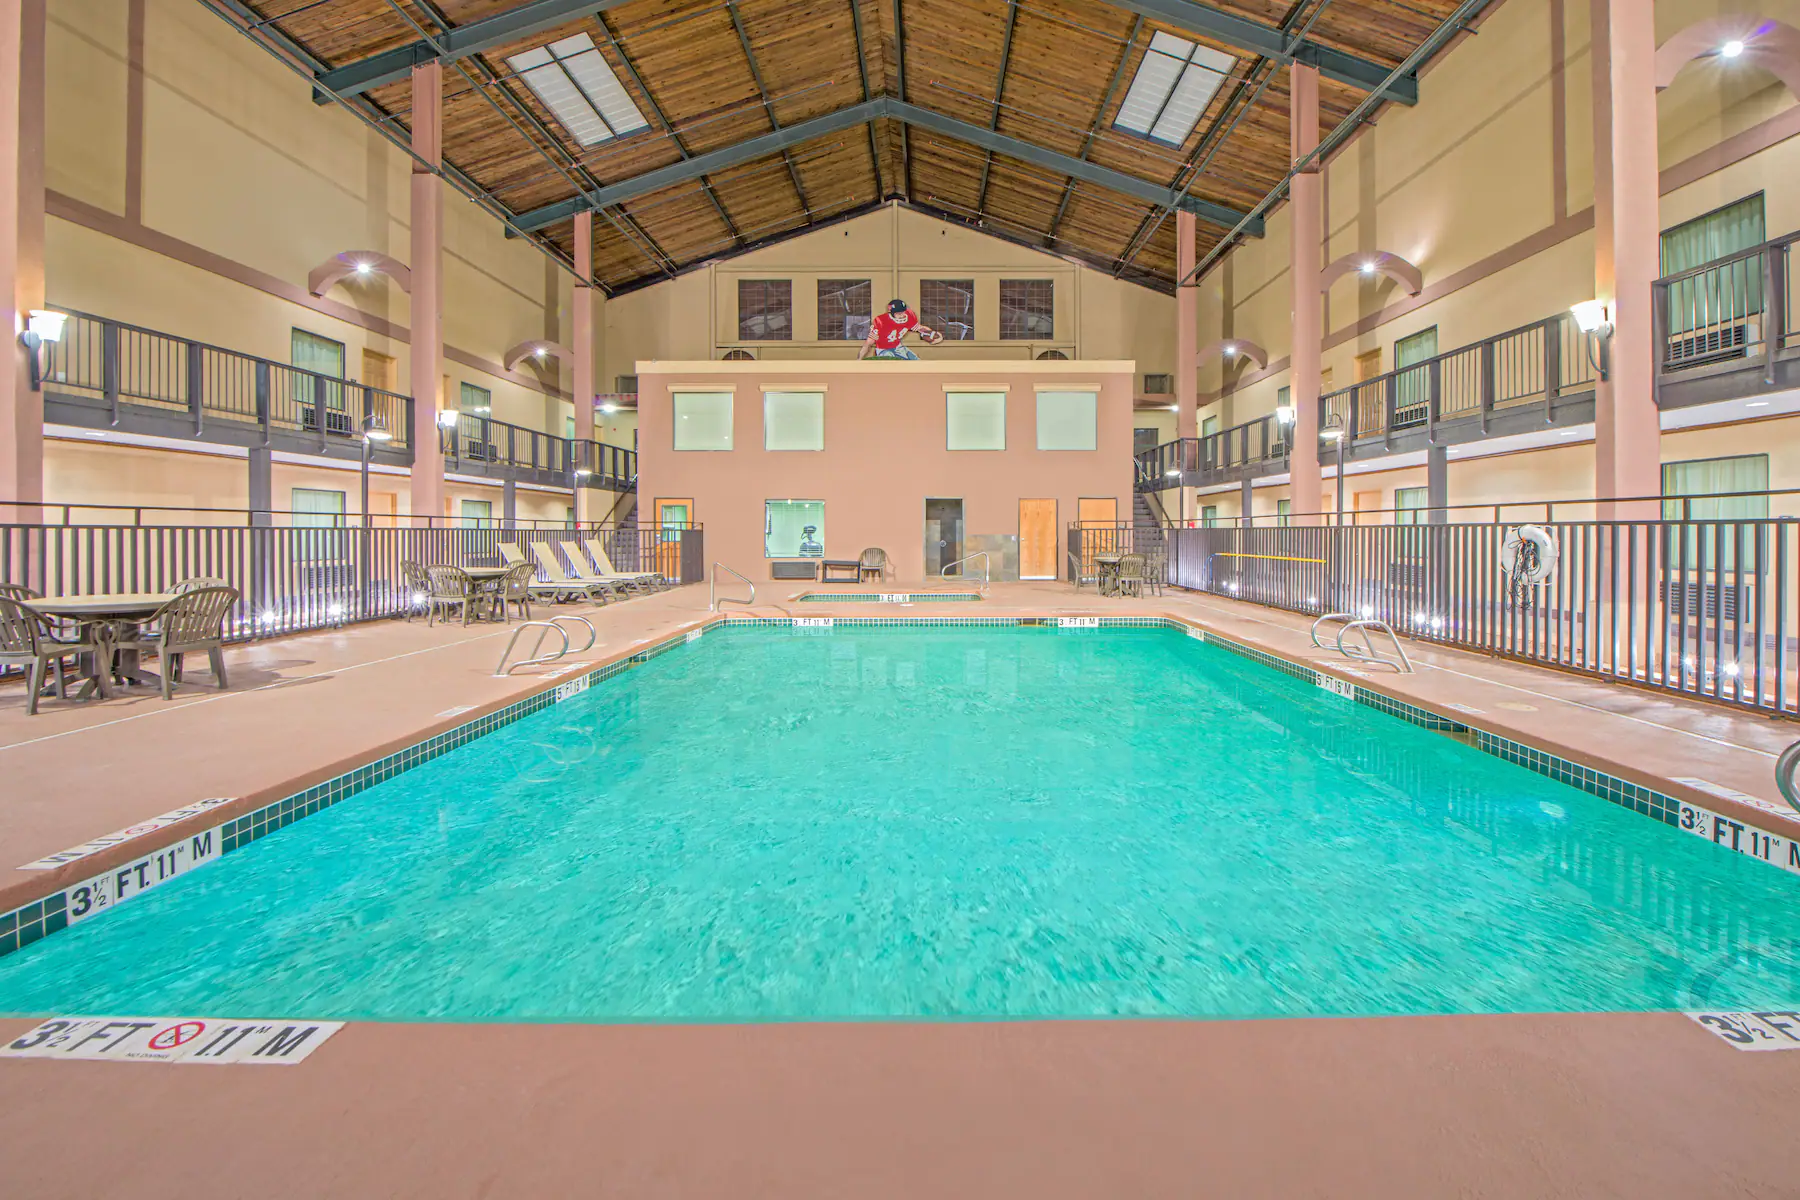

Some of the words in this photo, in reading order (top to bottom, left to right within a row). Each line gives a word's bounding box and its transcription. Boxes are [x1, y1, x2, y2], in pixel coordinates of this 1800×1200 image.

[1069, 617, 1077, 625] FT
[565, 681, 573, 695] FT
[1316, 674, 1322, 686] 5
[1325, 675, 1334, 688] FT
[1344, 682, 1351, 695] M
[193, 831, 212, 861] M
[66, 1022, 157, 1053] FT
[252, 1026, 320, 1057] M
